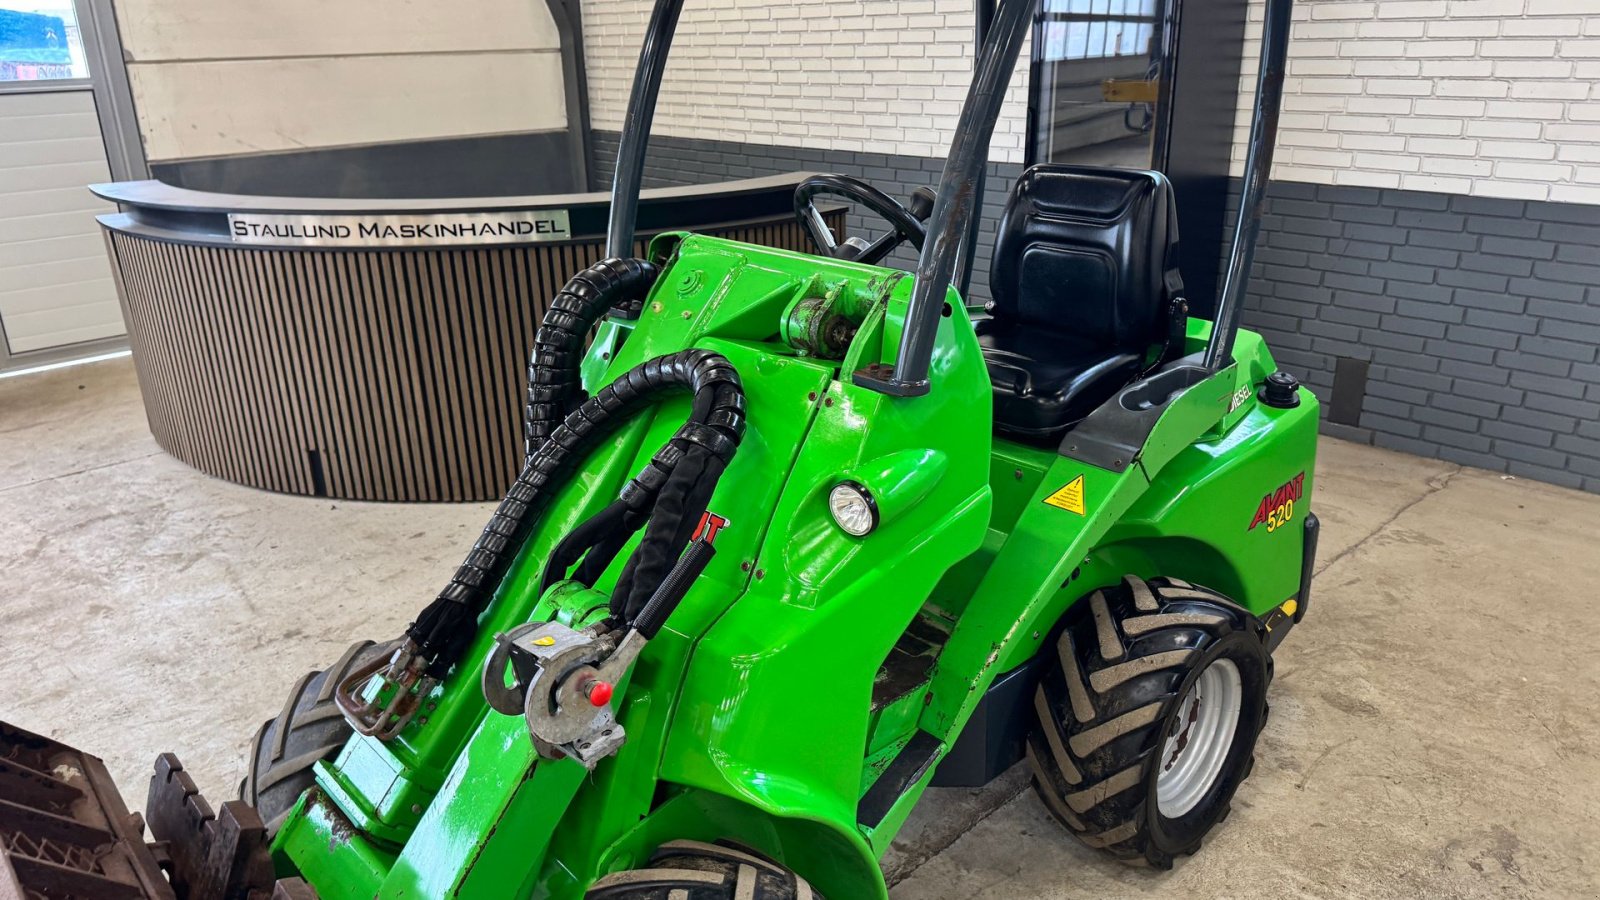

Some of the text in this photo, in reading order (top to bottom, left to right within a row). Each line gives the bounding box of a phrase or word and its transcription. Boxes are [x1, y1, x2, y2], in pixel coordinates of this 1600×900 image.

[233, 219, 565, 239] STAULUND MASKINHANDEL
[1248, 471, 1305, 531] AVANT
[1266, 498, 1293, 533] 520
